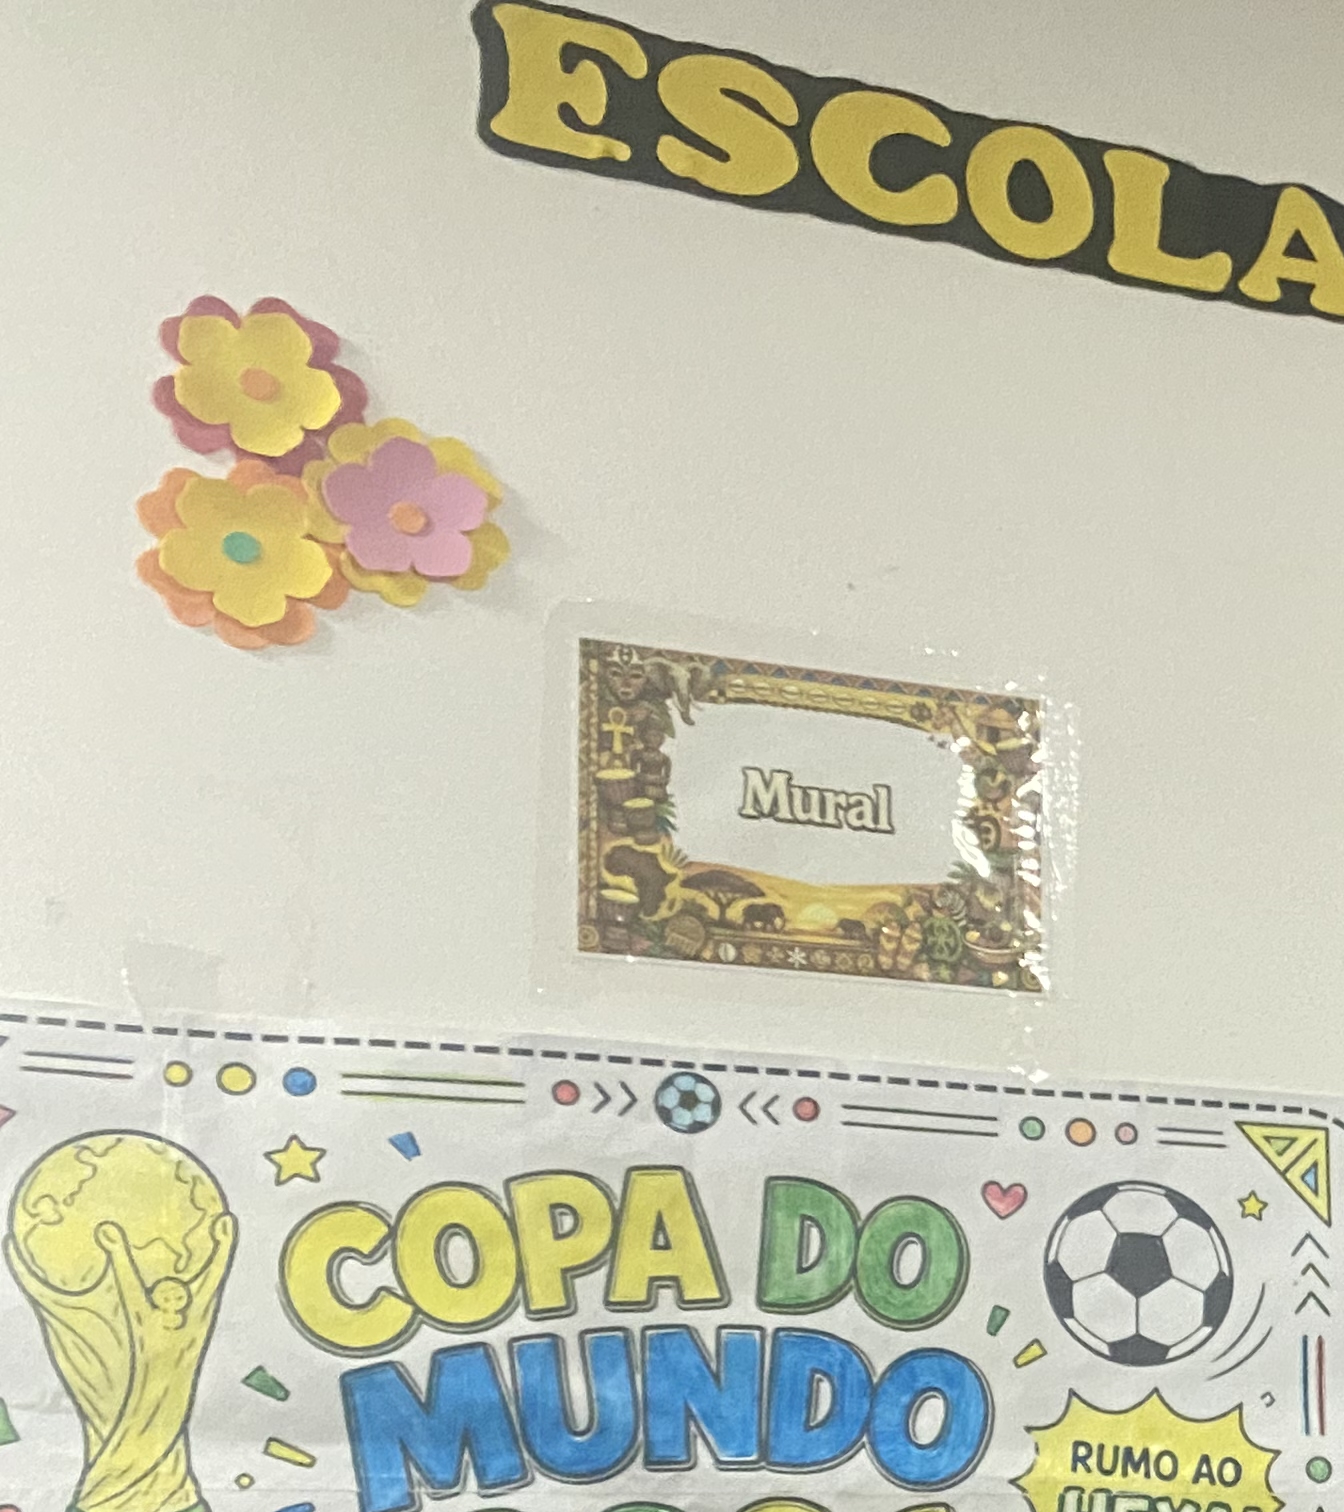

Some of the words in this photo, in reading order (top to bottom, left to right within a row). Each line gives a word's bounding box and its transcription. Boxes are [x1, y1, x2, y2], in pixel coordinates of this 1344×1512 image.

[738, 765, 895, 834] Mural
[278, 1165, 731, 1358] COPA
[756, 1175, 971, 1331] DO
[1070, 1439, 1179, 1482] RUMO
[1191, 1455, 1243, 1488] AO
